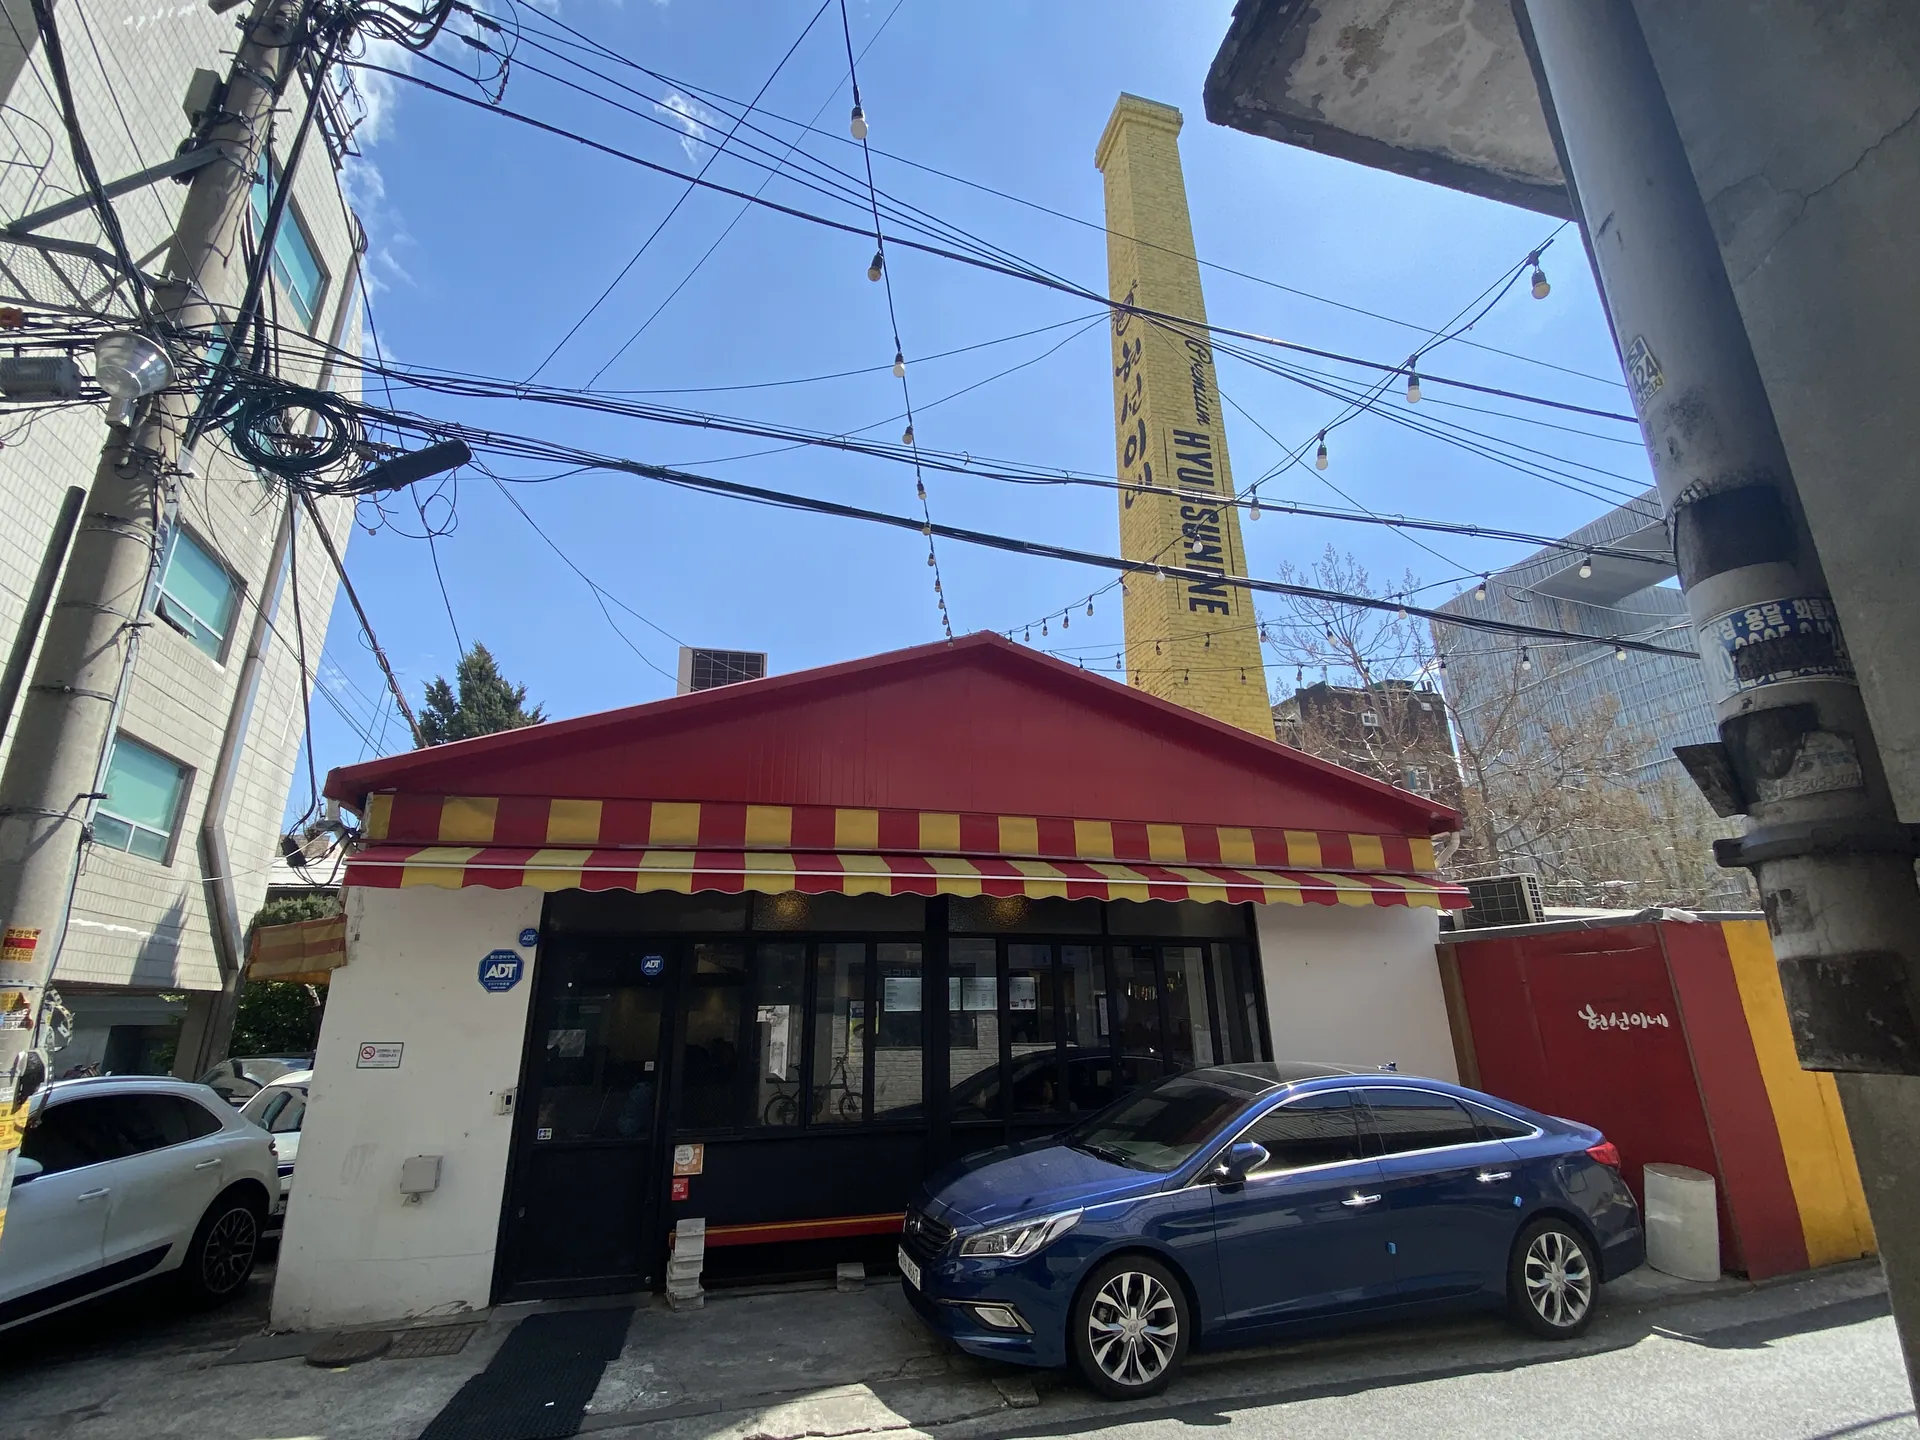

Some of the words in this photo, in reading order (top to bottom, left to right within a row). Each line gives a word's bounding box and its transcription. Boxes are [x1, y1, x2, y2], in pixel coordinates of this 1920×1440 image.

[1184, 339, 1212, 426] Premium
[484, 963, 518, 979] ADT
[644, 960, 661, 969] ADT
